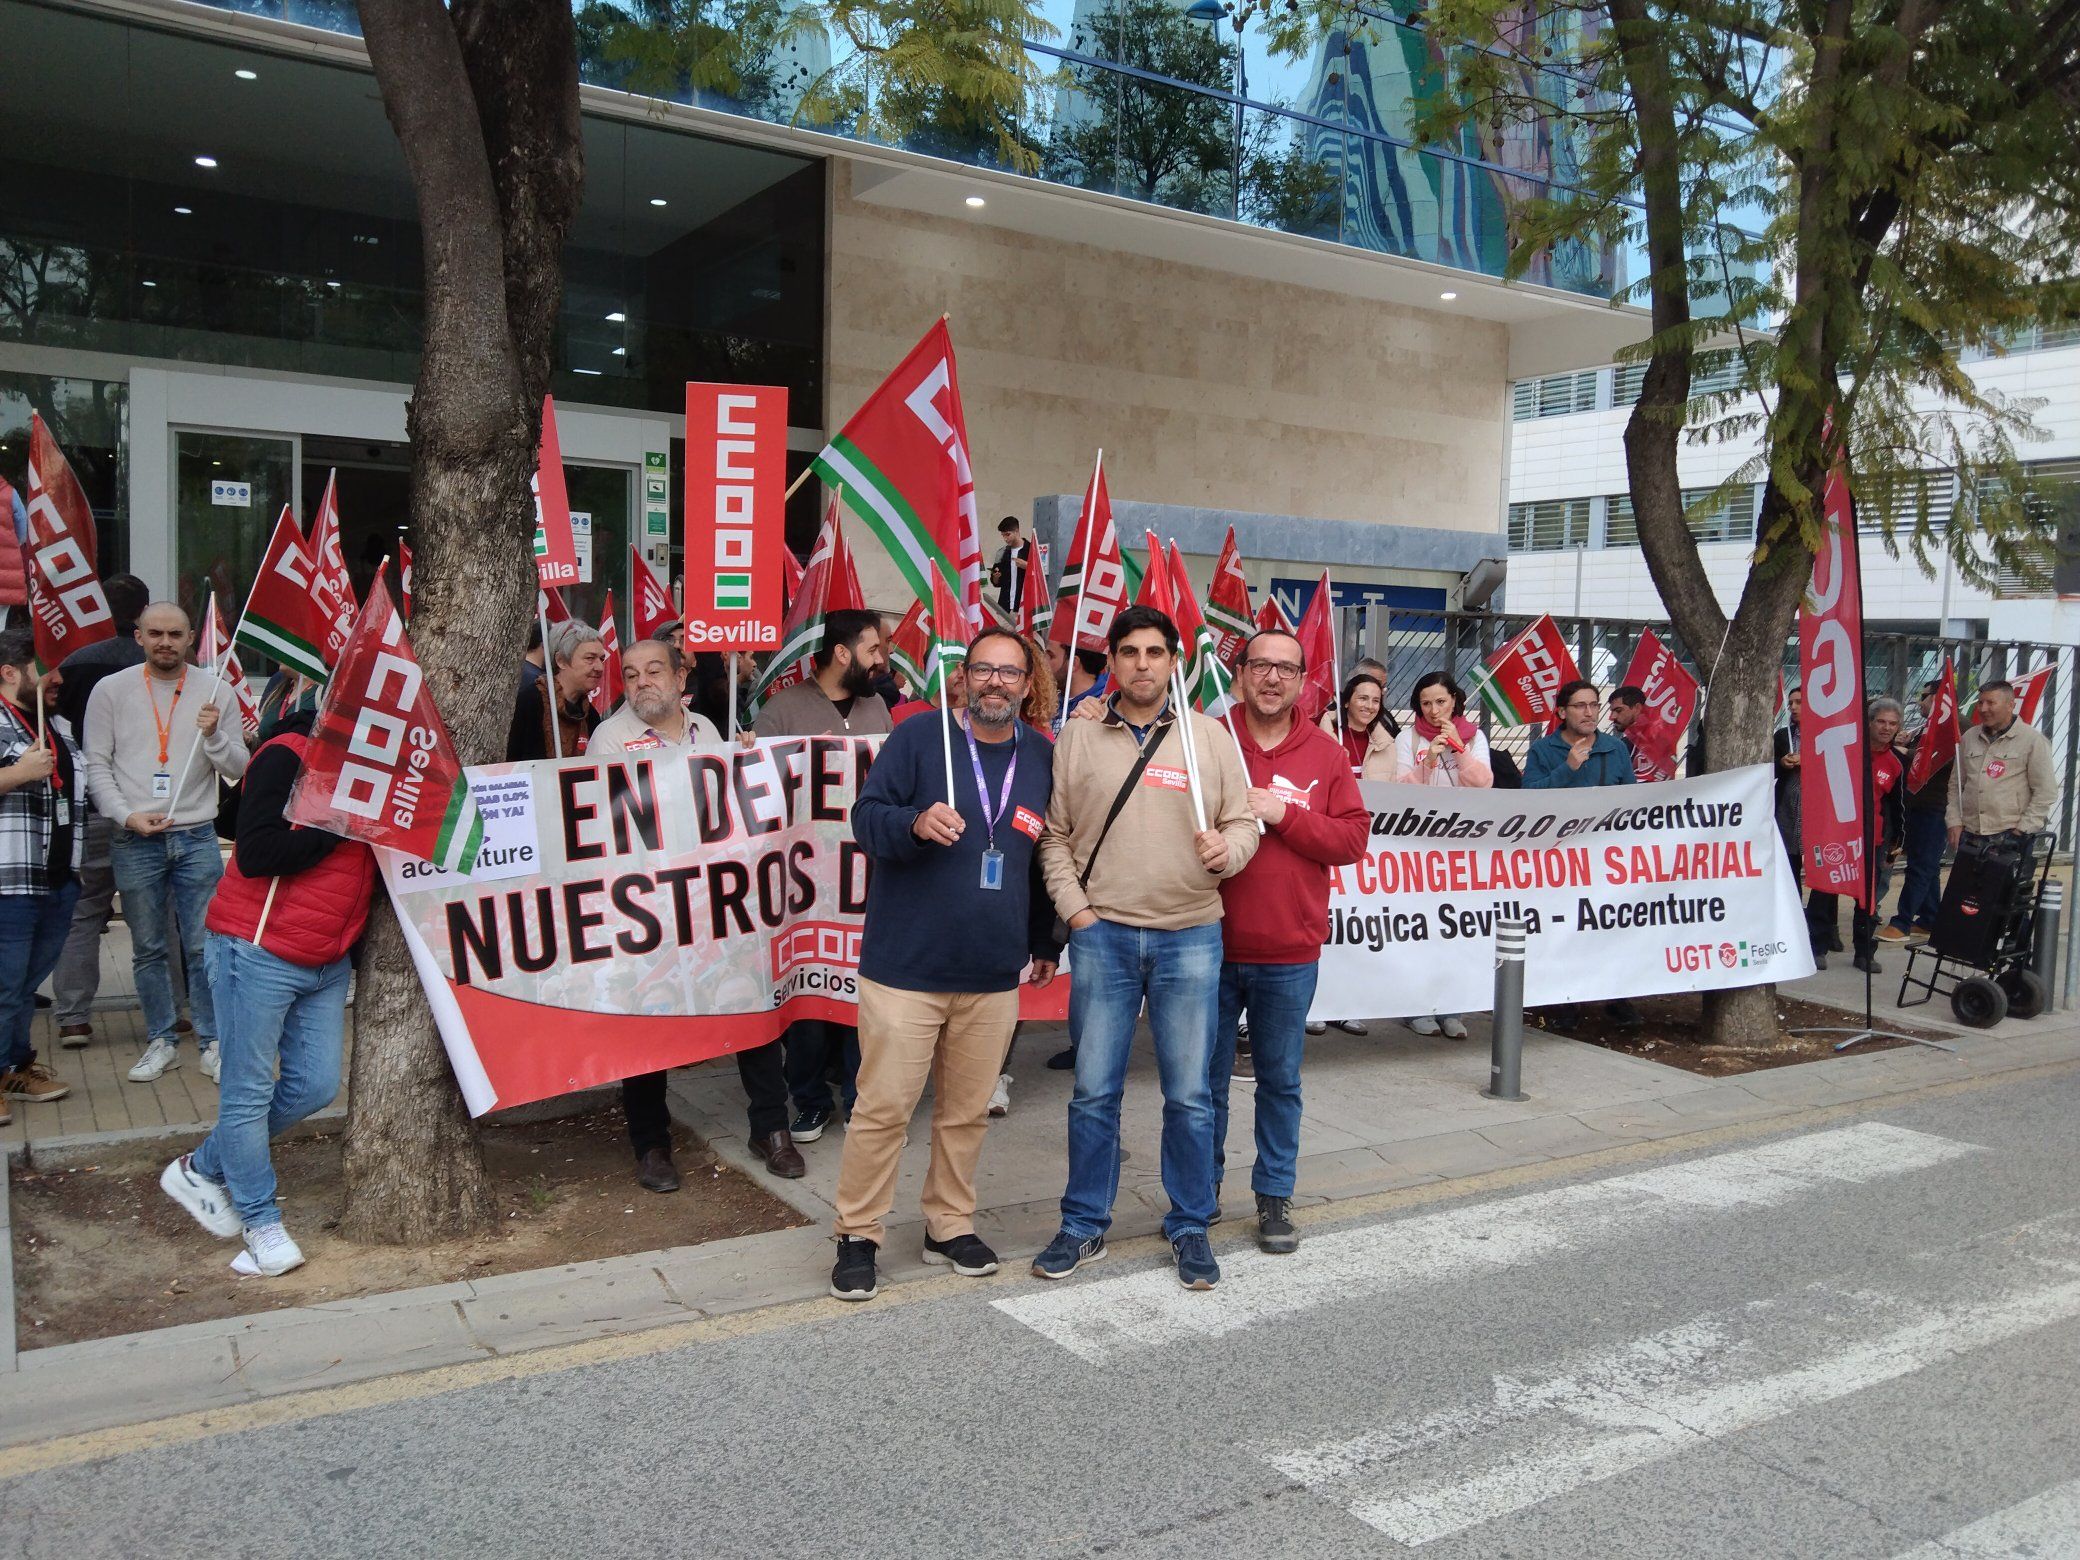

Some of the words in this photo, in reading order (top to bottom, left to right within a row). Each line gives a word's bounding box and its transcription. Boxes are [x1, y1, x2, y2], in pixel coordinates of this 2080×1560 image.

[714, 394, 757, 567] CCOO
[688, 620, 777, 644] Sevilla
[1516, 674, 1545, 714] Sevilla
[1162, 778, 1187, 789] Sevilla
[1988, 763, 2005, 773] UGT
[558, 759, 664, 861] EN
[1497, 814, 1557, 843] 0,0
[1592, 797, 1743, 832] Accenture
[1356, 841, 1591, 895] CONGELACIÓN
[1604, 840, 1763, 885] SALARIAL
[445, 840, 816, 986] NUESTROS
[1577, 893, 1726, 931] Accenture
[1665, 944, 1713, 973] UGT
[773, 967, 856, 1007] servicios
